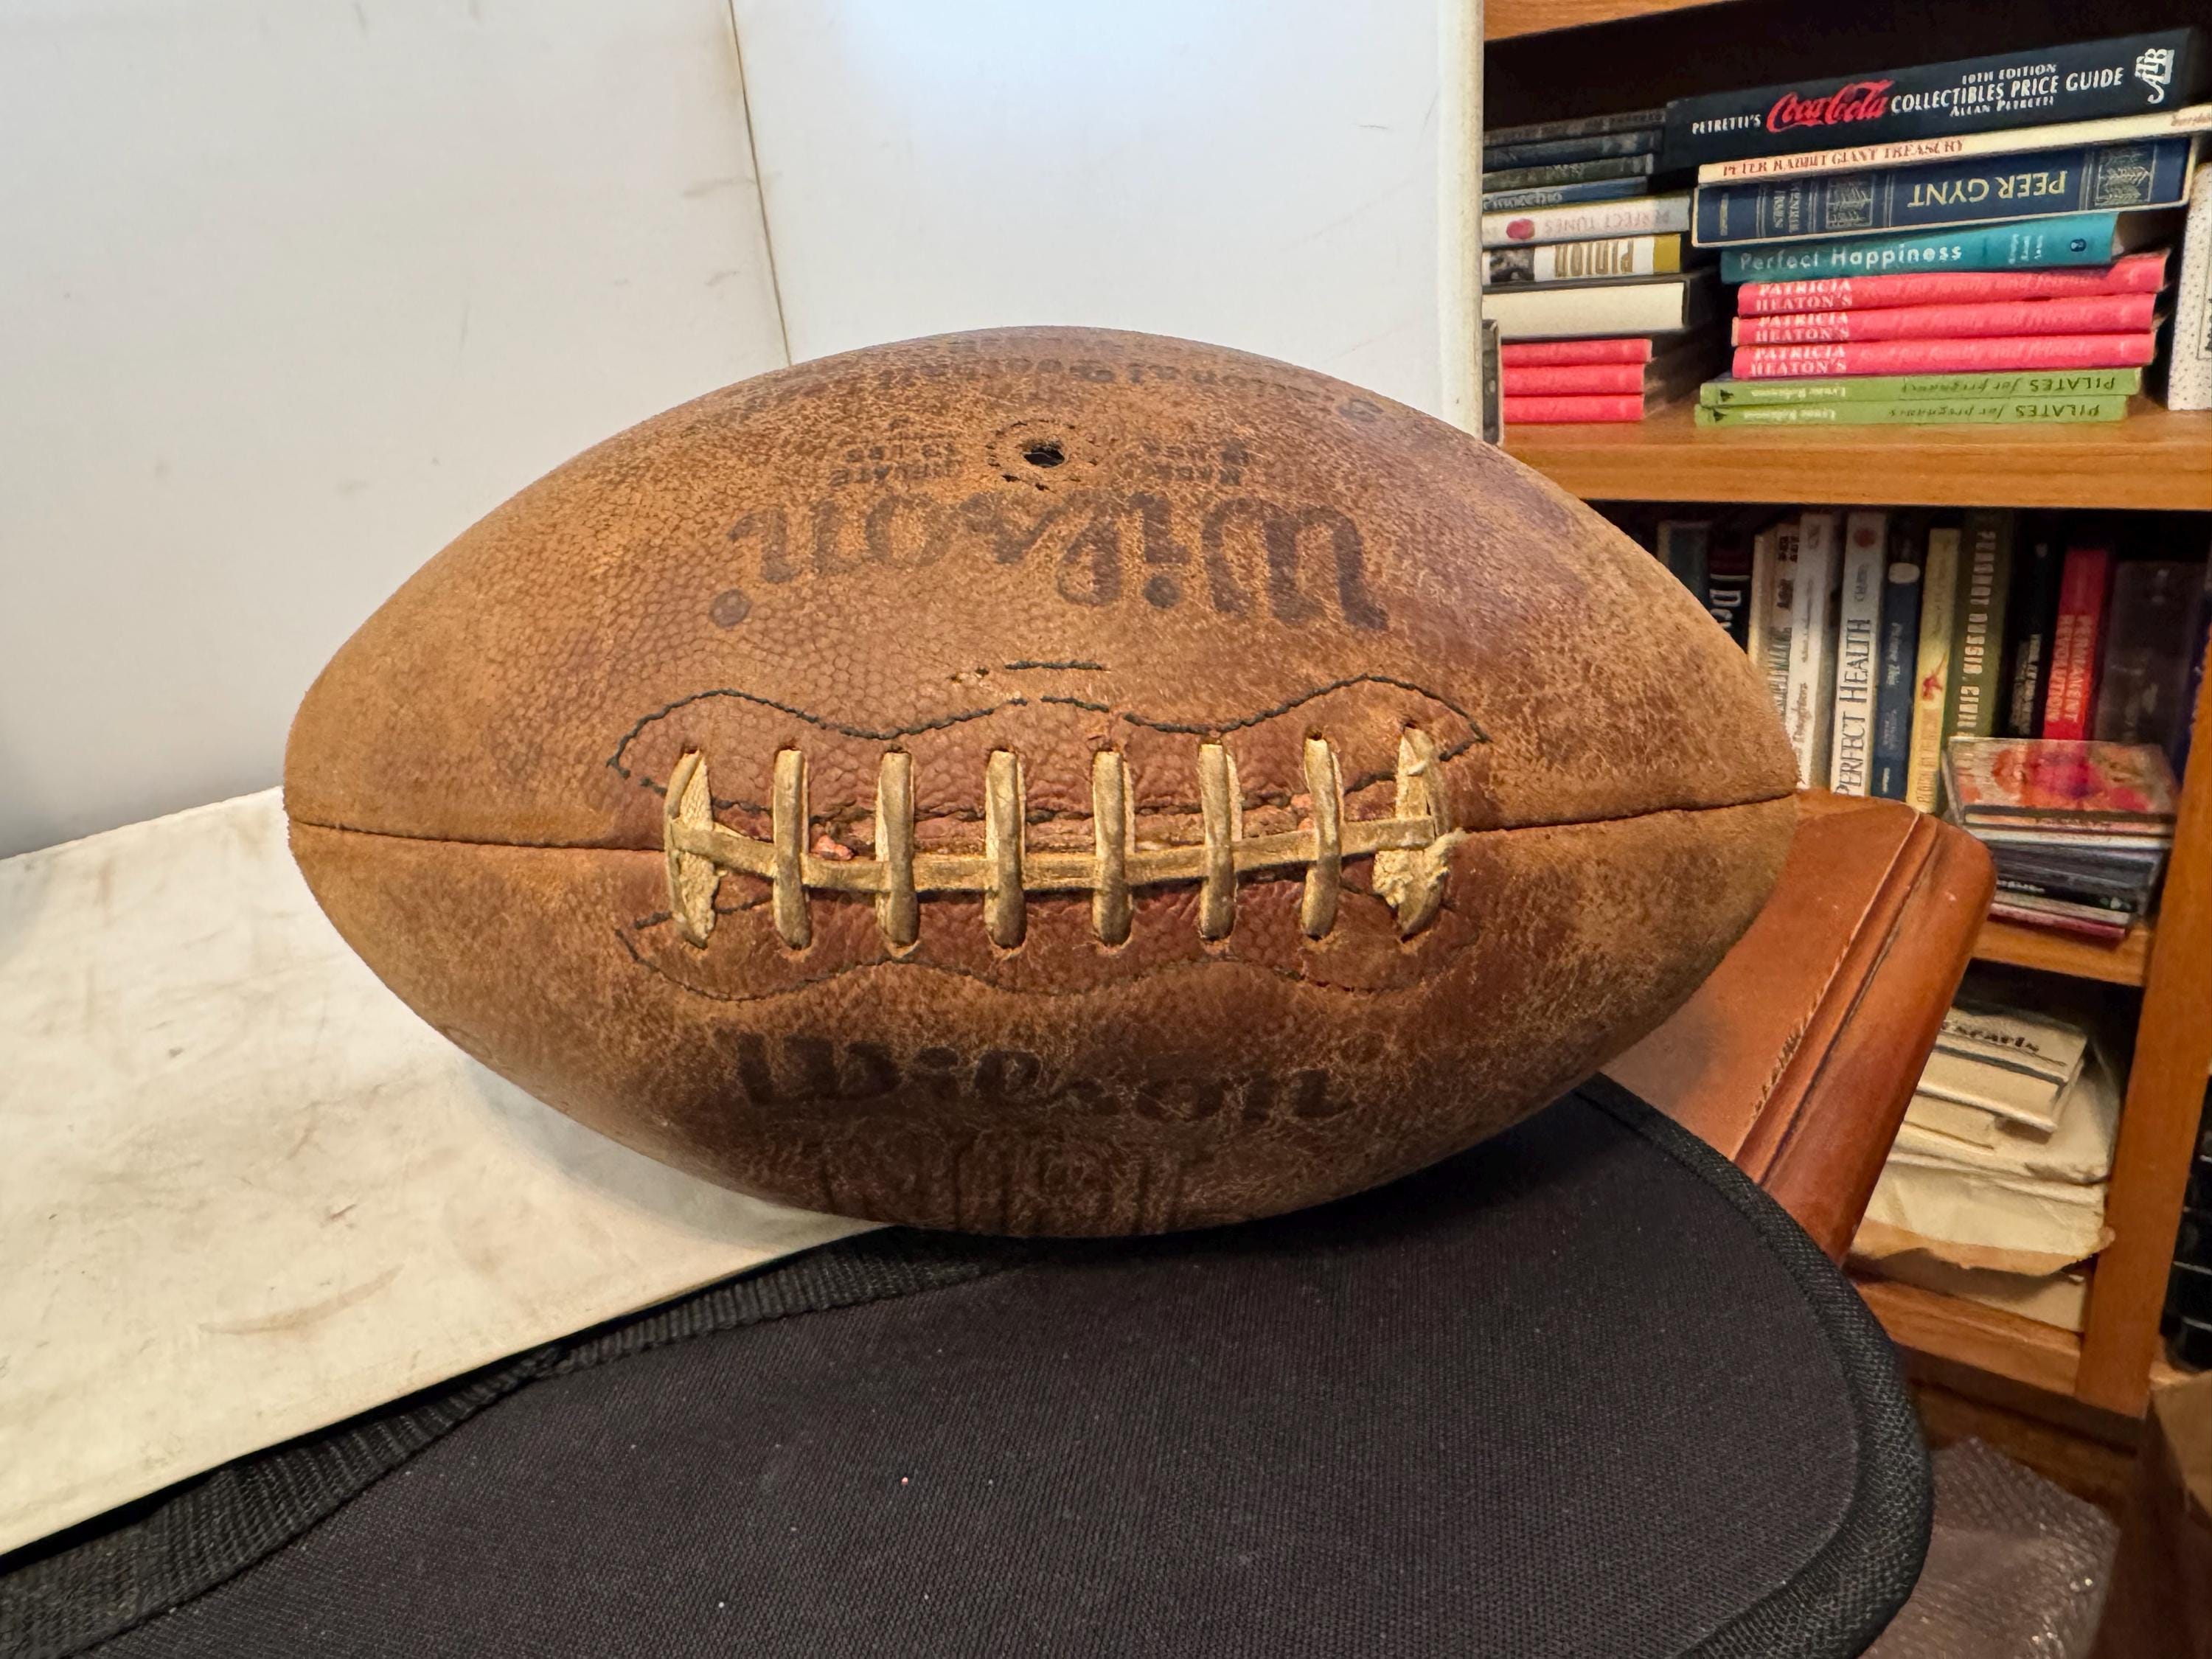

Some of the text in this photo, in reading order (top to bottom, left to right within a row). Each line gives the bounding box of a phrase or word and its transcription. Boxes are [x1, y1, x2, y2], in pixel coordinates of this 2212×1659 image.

[1998, 63, 2057, 80] EDITION
[1890, 82, 2005, 115] COLLECTIBLES
[2010, 74, 2059, 98] PRICE
[2065, 66, 2124, 92] GUIDE
[1832, 147, 1879, 164] GIANT
[1907, 170, 2067, 210] PEER GYNT
[1740, 243, 1963, 272] Perfect Happiness
[1759, 279, 1851, 295] PATRICIA
[1755, 293, 1853, 310] HEATON'S
[1758, 312, 1849, 328] PATRICIA
[1755, 326, 1851, 343] HEATON'S
[1753, 344, 1846, 362] PATRICIA
[1750, 360, 1848, 377] HEATON'S
[2028, 376, 2115, 392] PILATES
[2014, 404, 2100, 419] PILATES
[728, 489, 1388, 630] Wilson
[1838, 619, 1871, 706] HEALTH
[2046, 614, 2075, 723] REVOLUTION
[2066, 614, 2091, 723] PERMANENT
[1835, 711, 1867, 797] PERFECT
